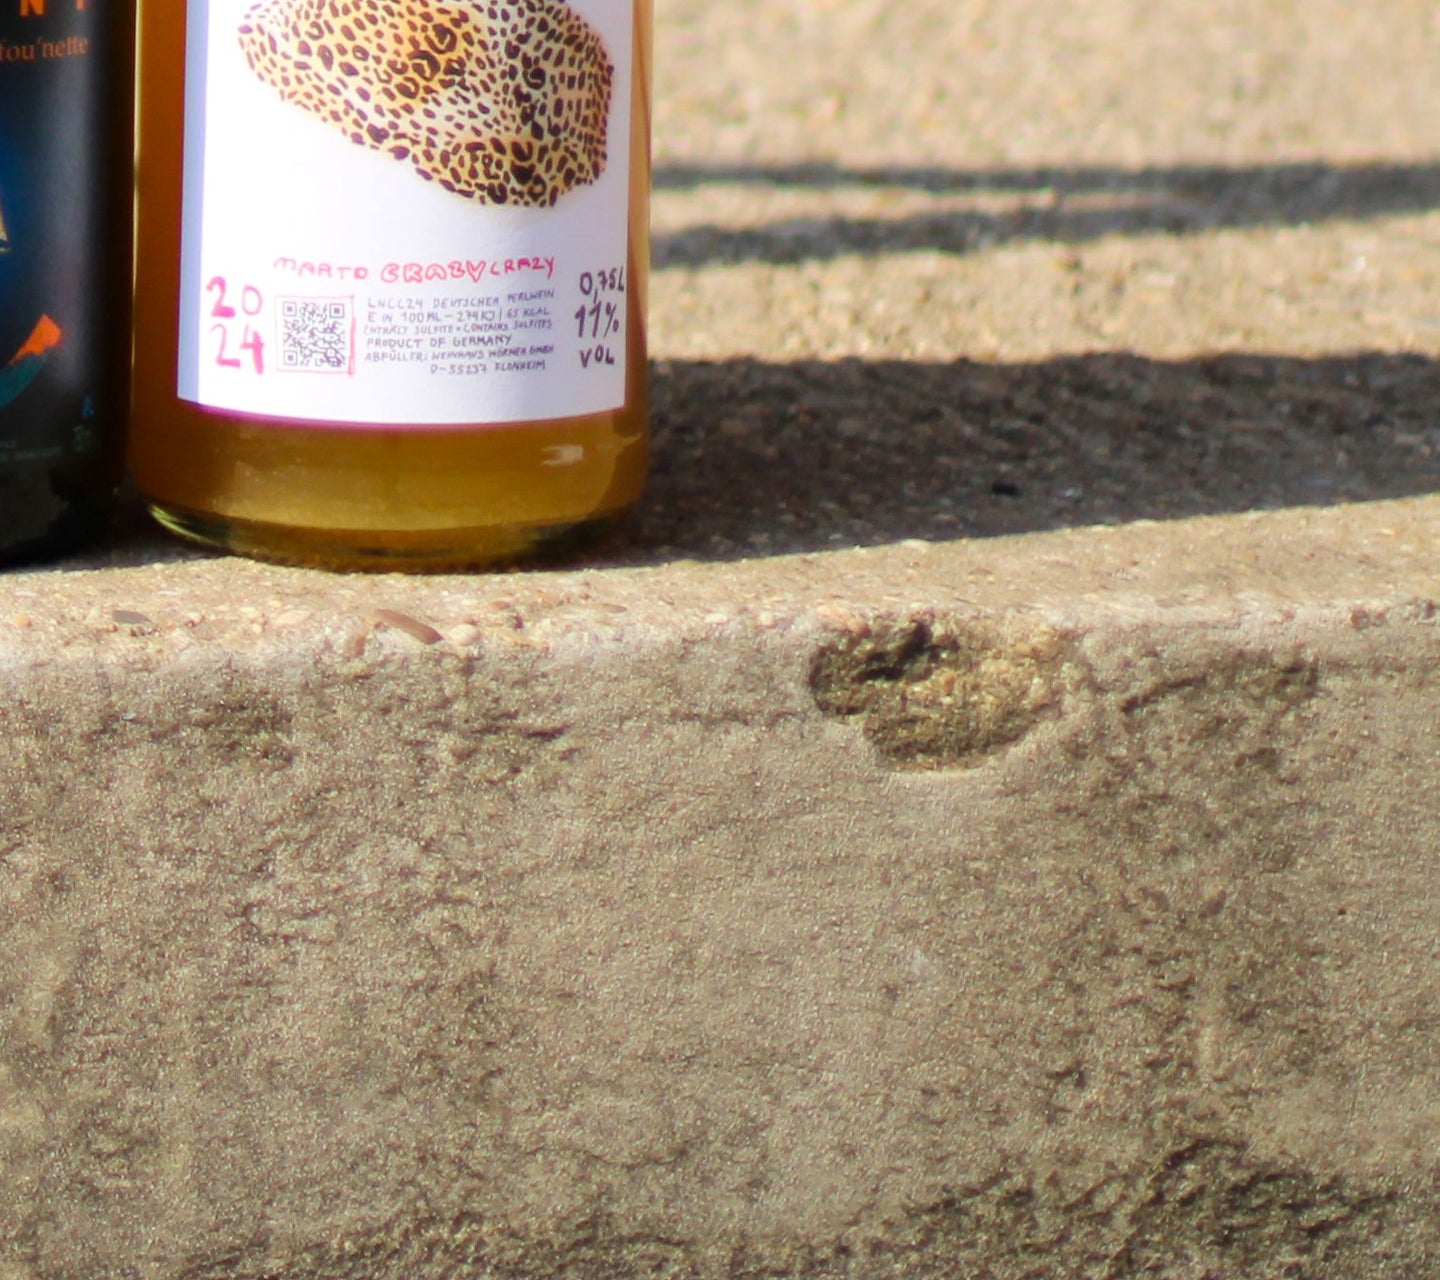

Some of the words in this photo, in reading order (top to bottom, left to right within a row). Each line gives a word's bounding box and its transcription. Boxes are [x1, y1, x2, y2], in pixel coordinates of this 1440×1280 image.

[490, 256, 555, 280] CRAZY
[206, 276, 264, 318] 20
[574, 300, 620, 338] 11%
[210, 323, 265, 375] 24
[366, 337, 424, 349] PRODUCT
[429, 336, 446, 348] OF
[452, 334, 512, 348] GERMANY
